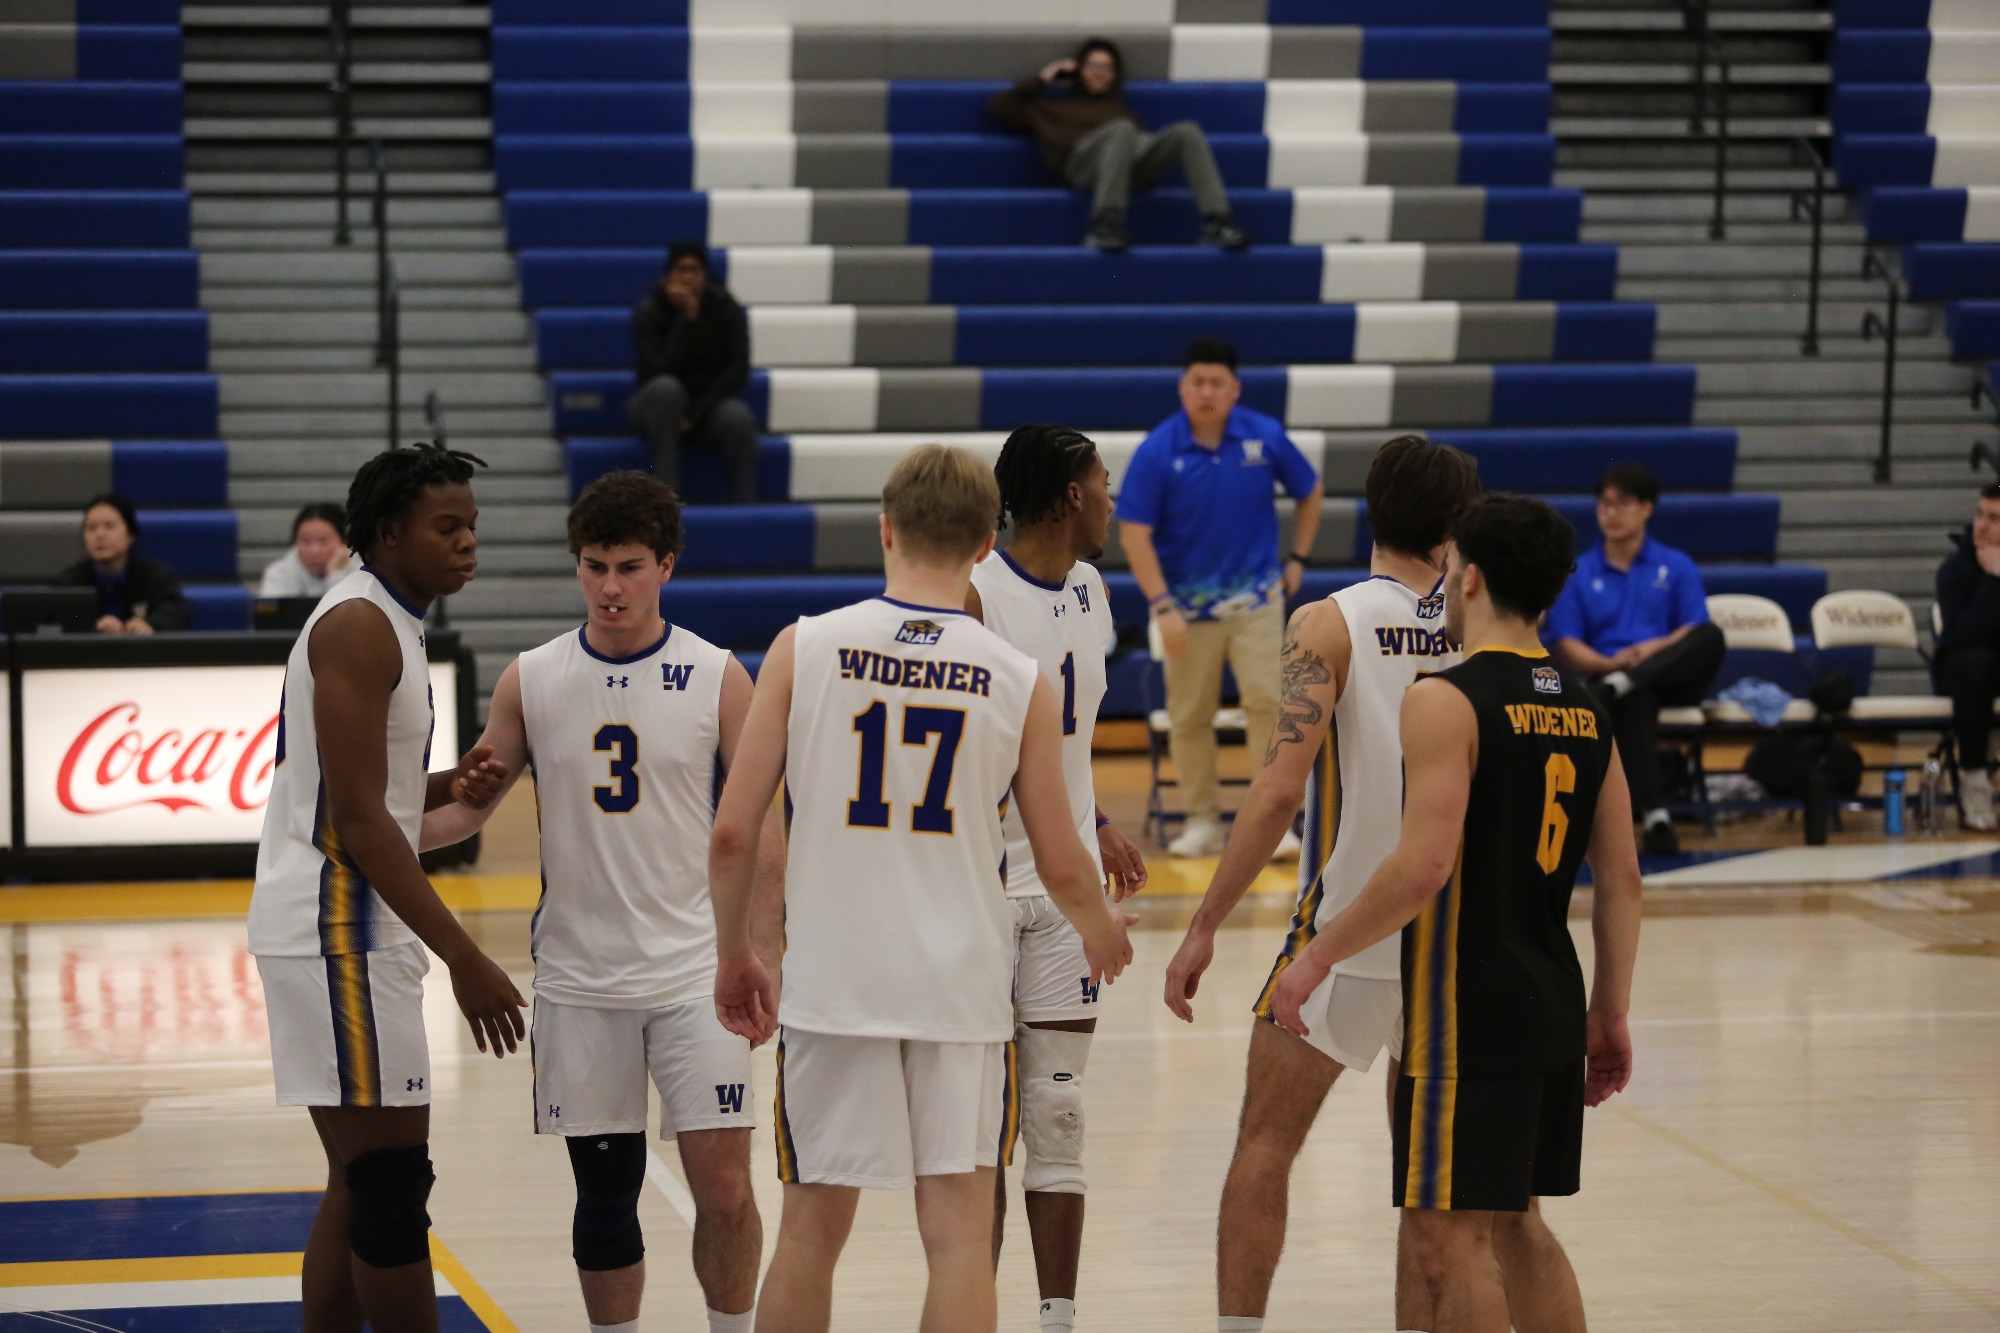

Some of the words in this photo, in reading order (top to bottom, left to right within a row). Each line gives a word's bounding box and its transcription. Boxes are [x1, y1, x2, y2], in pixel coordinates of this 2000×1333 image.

[1072, 584, 1091, 613] W
[1712, 608, 1778, 631] idener
[1825, 605, 1905, 629] Widener
[898, 628, 940, 645] MAC
[1374, 626, 1464, 656] WIDEN
[661, 663, 695, 691] W
[838, 648, 992, 697] WIDENER
[1534, 678, 1559, 691] MAC
[1059, 649, 1078, 737] 1
[1504, 703, 1599, 740] WIDENER
[56, 701, 280, 815] Coca-C
[592, 722, 640, 814] 3
[845, 698, 968, 836] 17
[1536, 753, 1577, 875] 6
[715, 1083, 745, 1113] W
